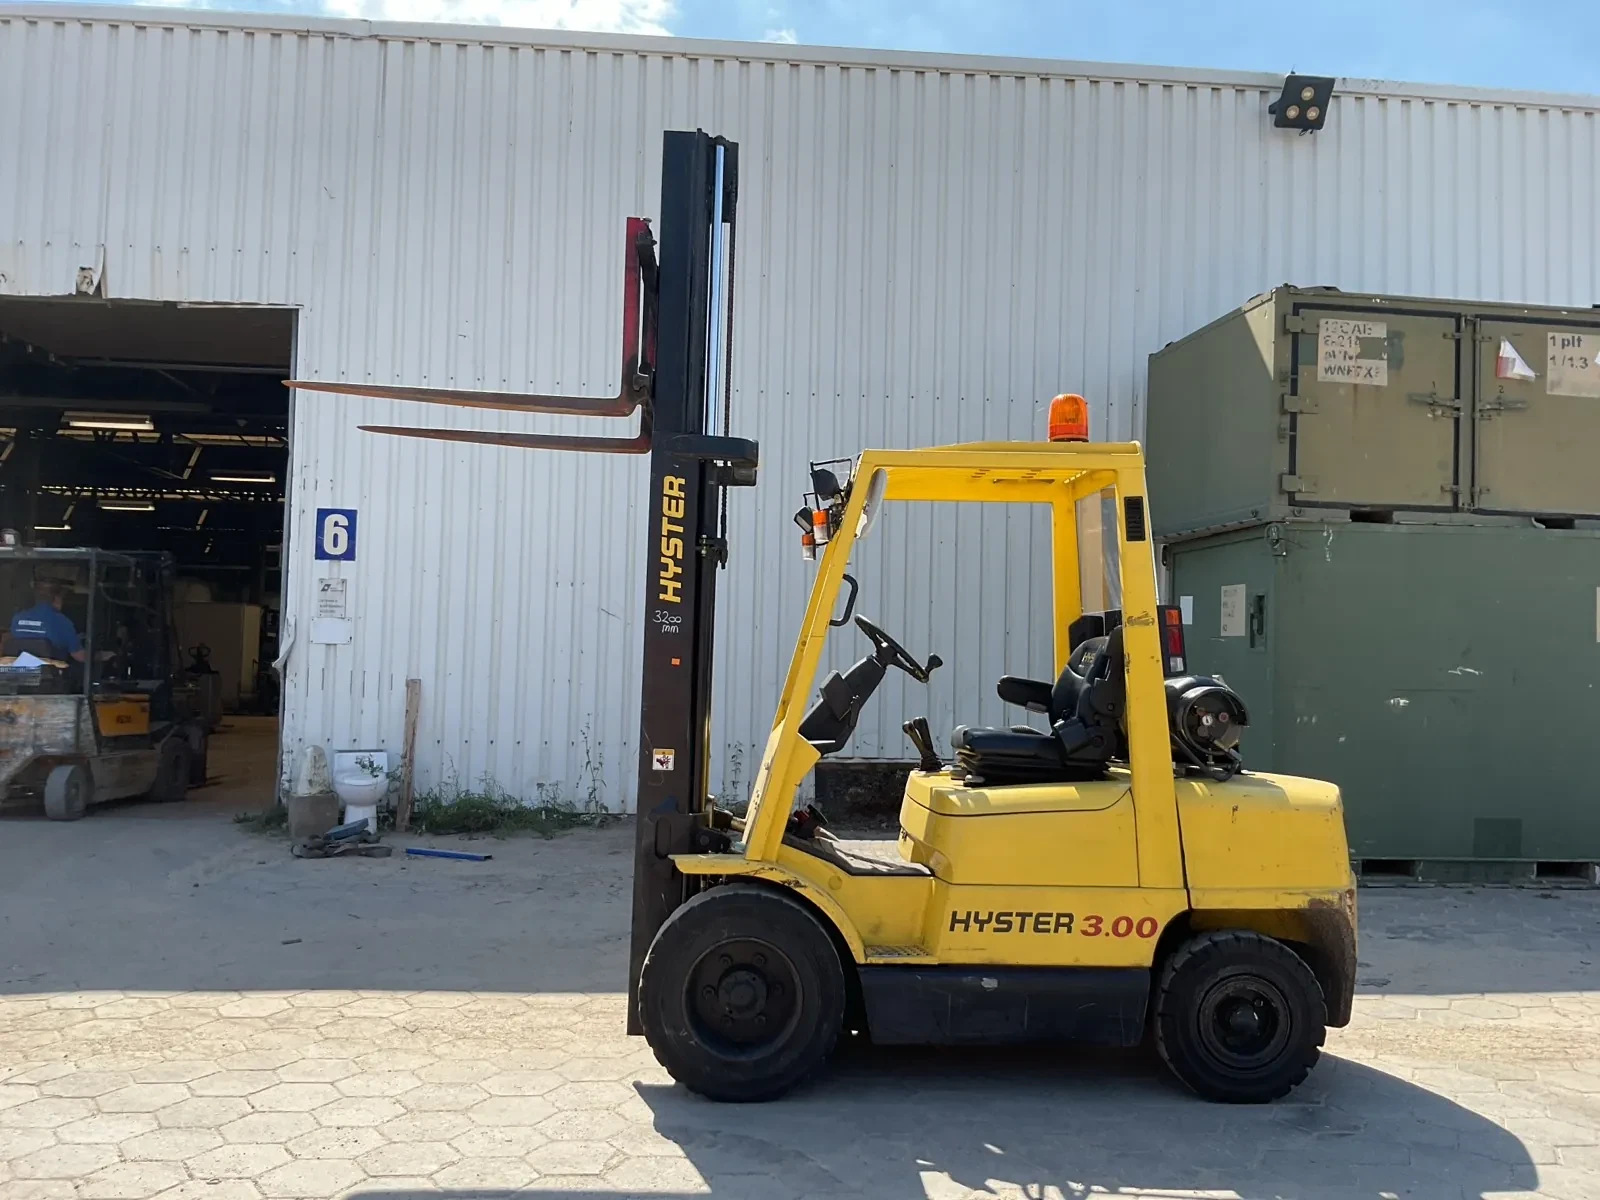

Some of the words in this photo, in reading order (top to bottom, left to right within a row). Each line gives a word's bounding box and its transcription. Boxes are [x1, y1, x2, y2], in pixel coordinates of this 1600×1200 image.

[323, 513, 349, 556] 6
[658, 474, 686, 603] HYSTER
[949, 910, 1075, 934] HYSTER
[1080, 914, 1159, 939] 3.00
